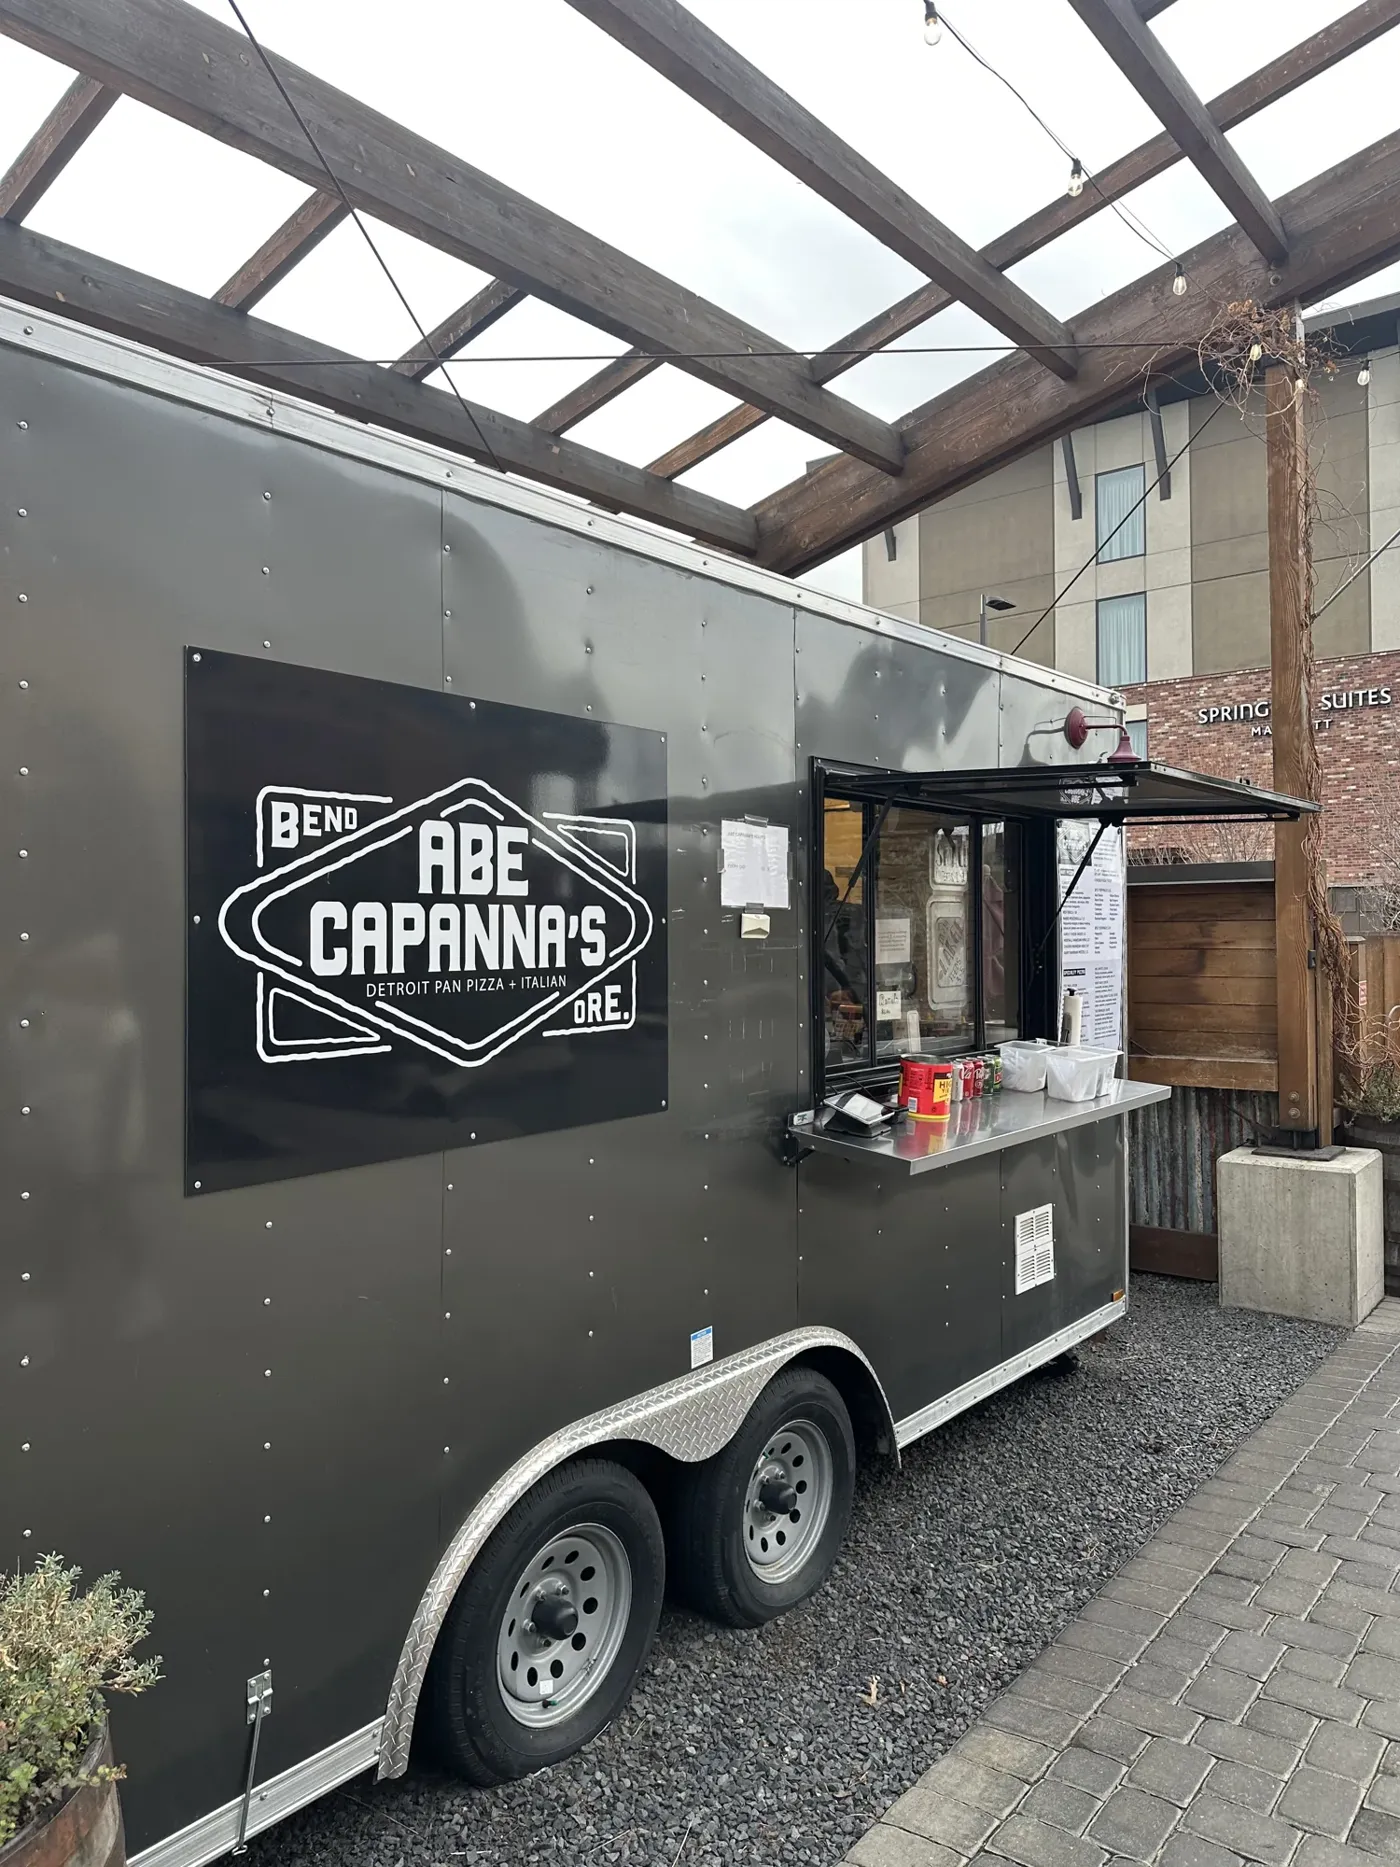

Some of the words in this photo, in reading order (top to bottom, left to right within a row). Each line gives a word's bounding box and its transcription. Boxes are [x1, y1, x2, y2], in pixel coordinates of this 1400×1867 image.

[1198, 701, 1271, 724] SPRING
[1321, 687, 1392, 711] SUITES
[271, 800, 358, 848] BEND
[418, 819, 529, 896] ABE
[309, 900, 607, 977] CAPANNA'S
[366, 981, 430, 998] DETROIT
[435, 979, 461, 994] PAN
[467, 977, 504, 992] PIZZA
[521, 975, 566, 989] ITALIAN
